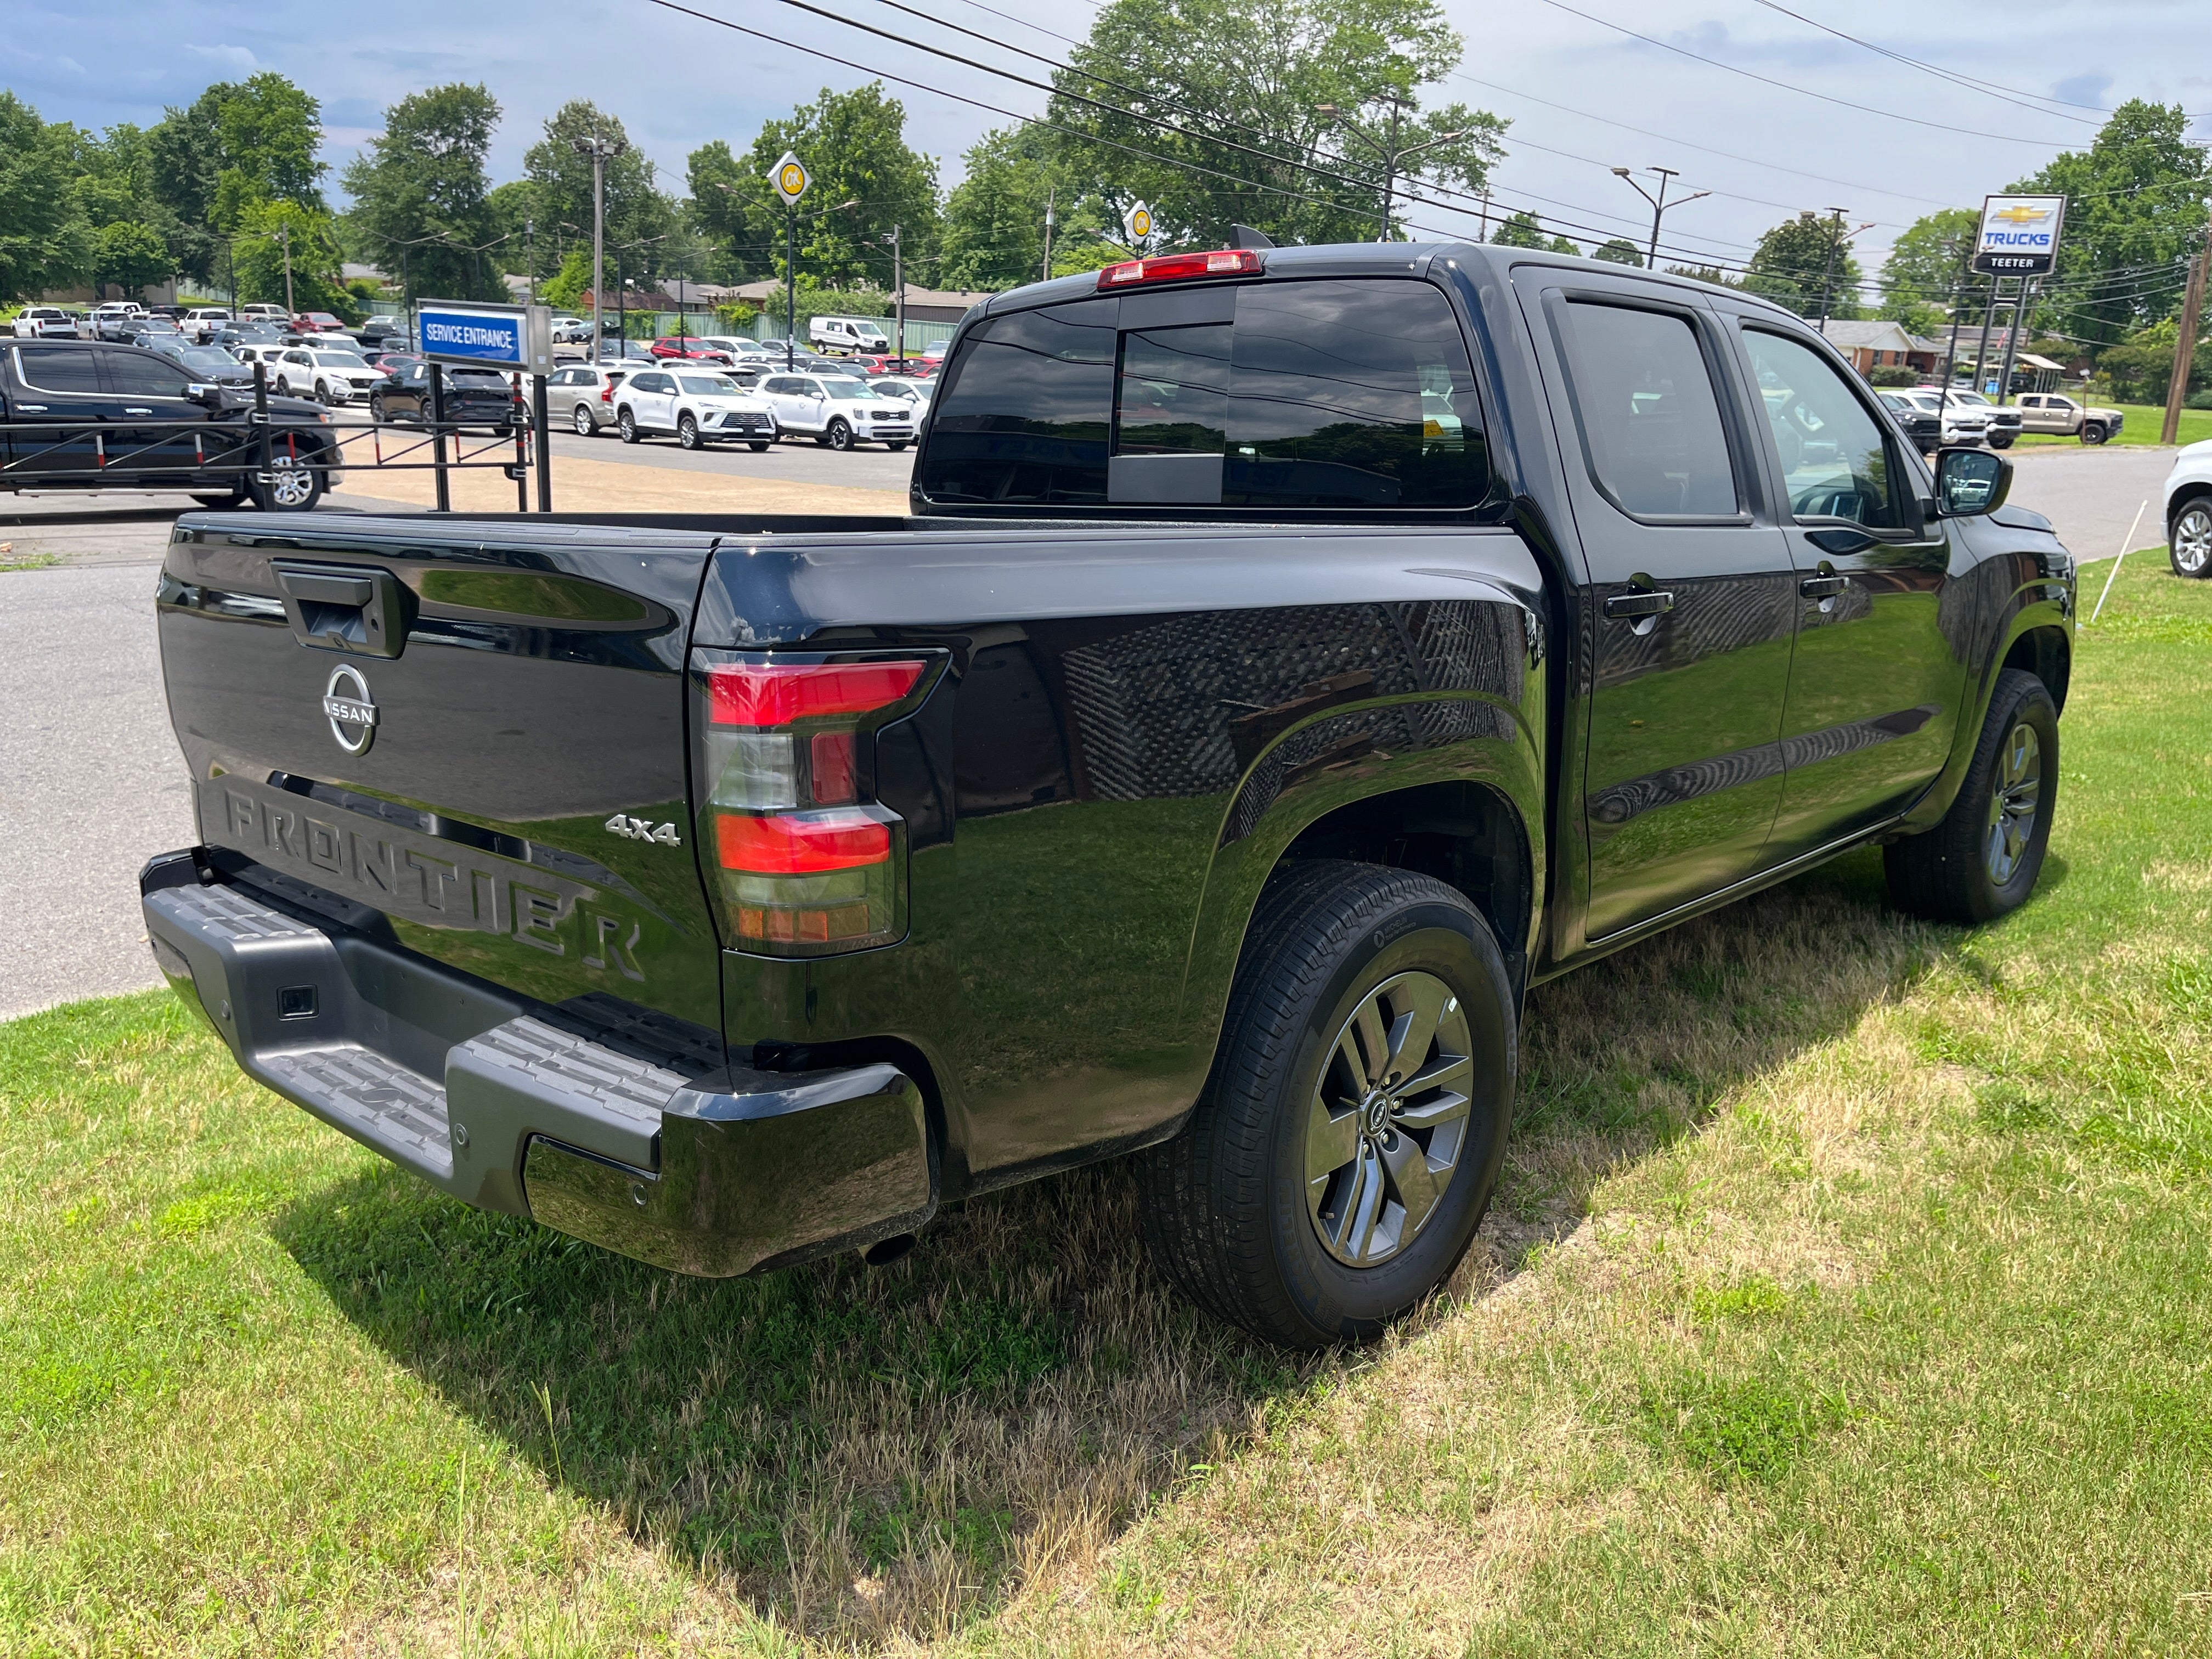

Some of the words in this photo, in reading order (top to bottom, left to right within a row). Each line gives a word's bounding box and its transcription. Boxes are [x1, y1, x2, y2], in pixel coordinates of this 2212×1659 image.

[785, 168, 801, 187] OK
[1985, 233, 2050, 245] TRUCKS
[1991, 257, 2034, 268] TEETER
[426, 323, 463, 343] SERVICE
[464, 326, 513, 349] ENTRANCE
[324, 699, 373, 723] NISSAN
[225, 788, 646, 983] FRONTIER
